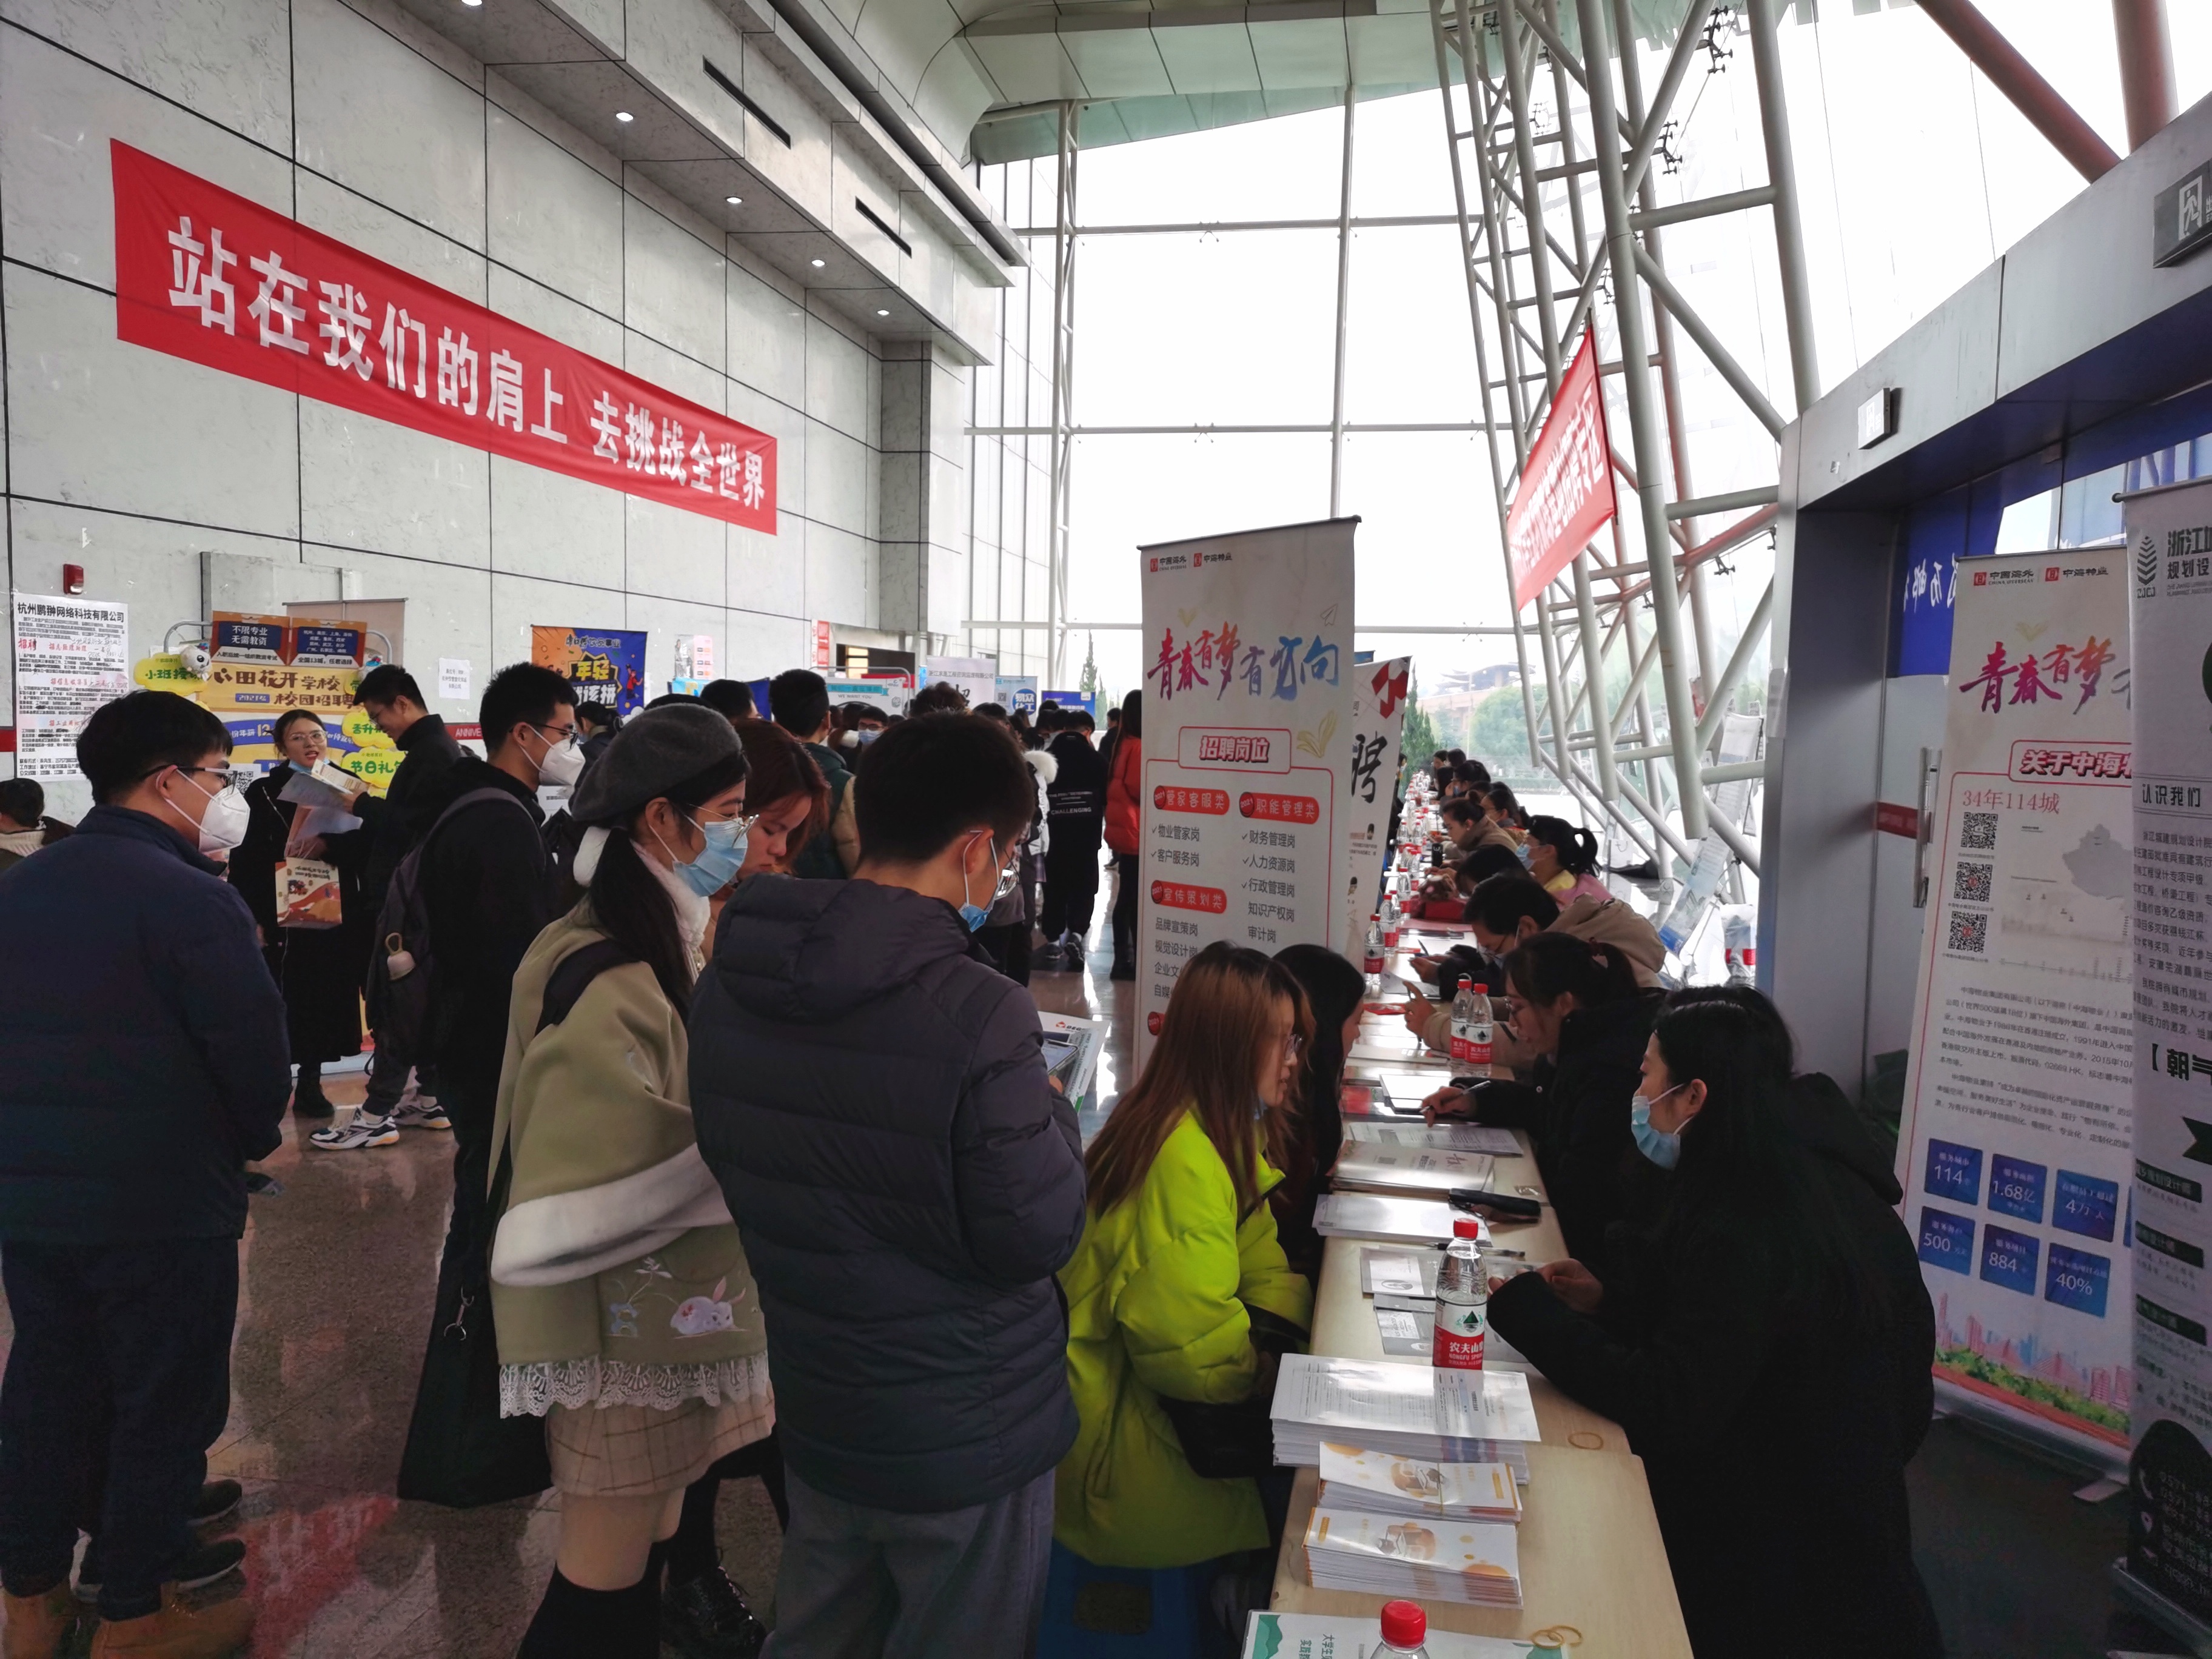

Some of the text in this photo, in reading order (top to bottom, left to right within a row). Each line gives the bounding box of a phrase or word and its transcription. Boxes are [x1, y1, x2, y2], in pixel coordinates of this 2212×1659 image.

[167, 215, 765, 511] 站在我们的肩上 去挑战全世界
[2167, 557, 2210, 580] 规划设
[231, 635, 267, 646] 无需教资
[232, 625, 268, 636] 不限专业
[145, 666, 202, 680] 小班授
[576, 660, 609, 681] 年轻
[274, 691, 355, 709] 校园招聘
[1199, 736, 1270, 763] 招聘岗位
[1167, 789, 1225, 809] 管家客服类
[1962, 789, 2060, 814] 34年114城
[2142, 783, 2201, 807] 认识我们
[1256, 799, 1316, 818] 职能管理类
[1158, 823, 1200, 842] 物业管家岗
[1248, 830, 1295, 848] 财务管理岗
[1157, 847, 1200, 867] 客户服务岗
[1248, 854, 1295, 873] 人力资源岗
[1248, 878, 1295, 897] 行政管理岗
[1164, 888, 1222, 909] 宣传策划类
[1247, 903, 1295, 923] 知识产权岗
[1156, 917, 1198, 937] 品牌宣策岗
[1247, 925, 1276, 943] 审计岗
[1155, 961, 1183, 976] 企业文
[1935, 1165, 1963, 1185] 114
[1992, 1180, 2035, 1204] 1.68亿
[1923, 1233, 1951, 1252] 500
[1989, 1252, 2017, 1272] 884
[2055, 1273, 2093, 1296] 40%
